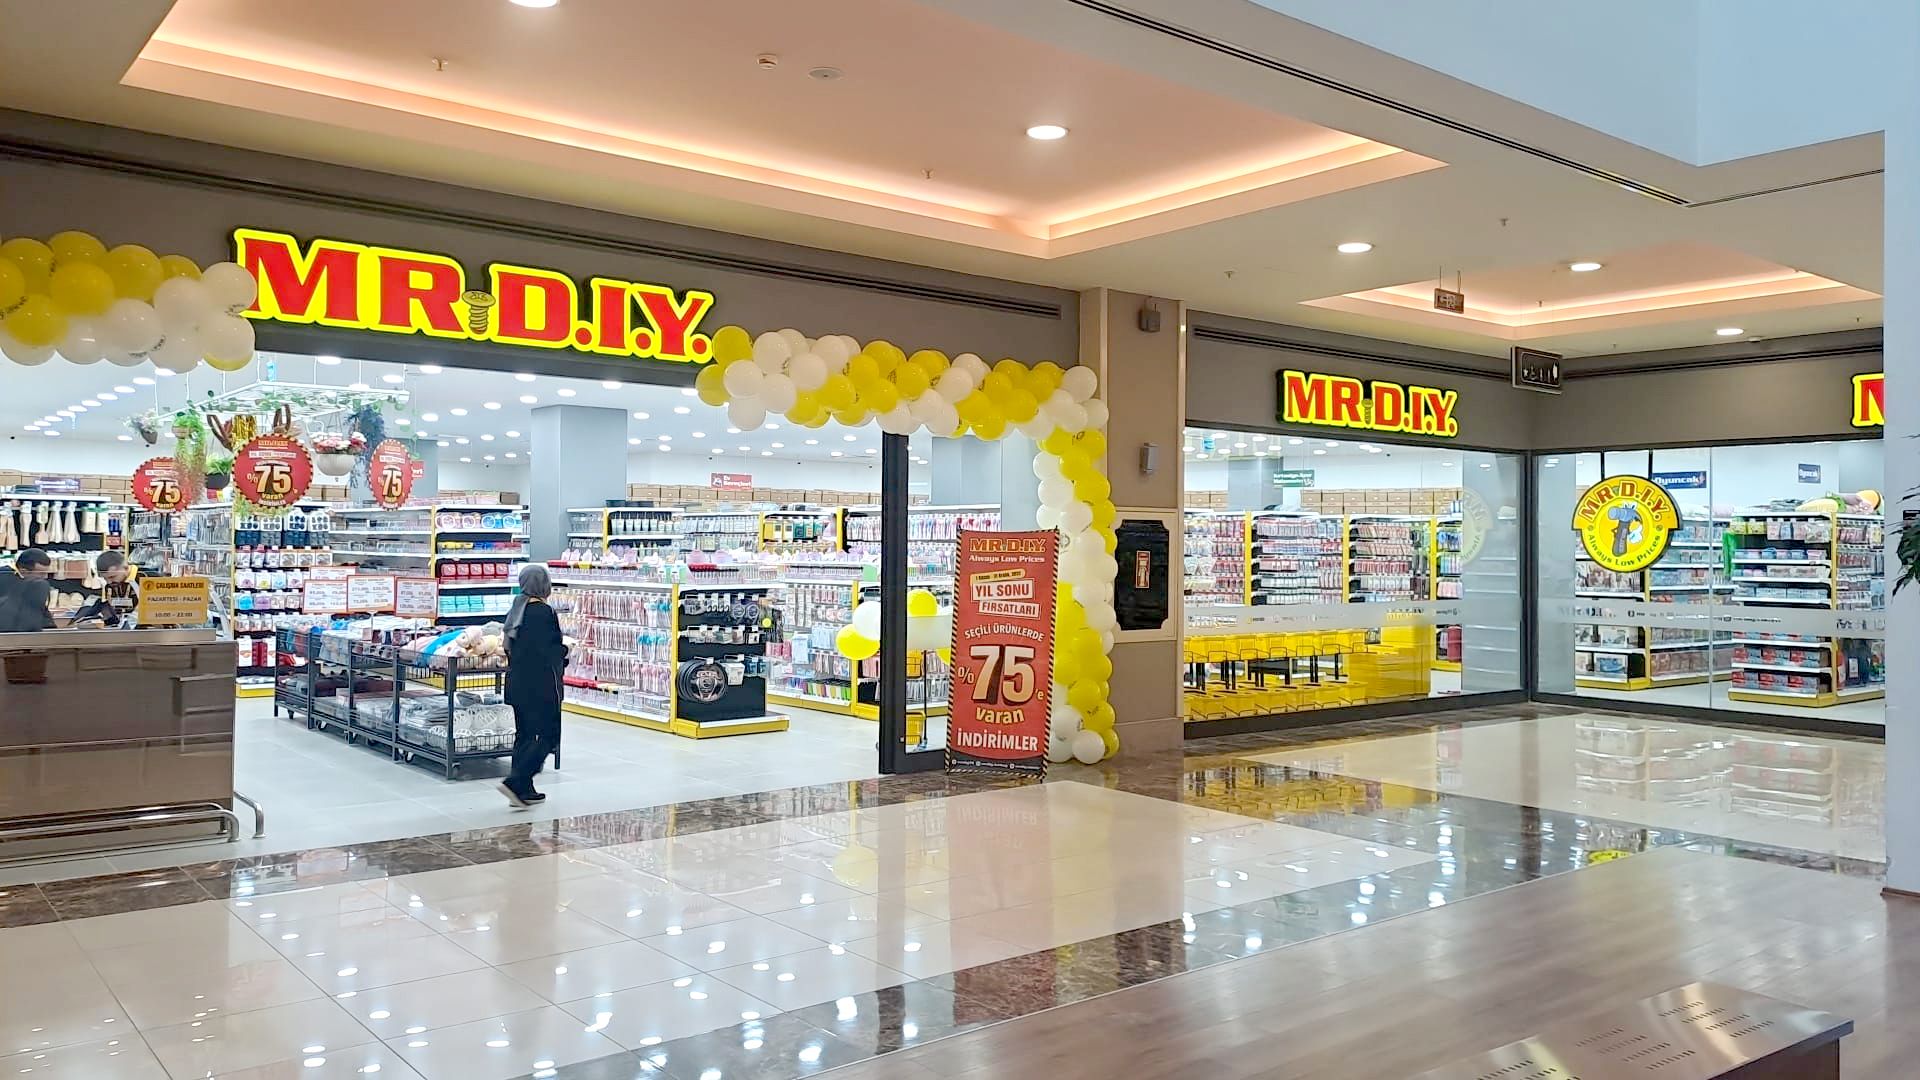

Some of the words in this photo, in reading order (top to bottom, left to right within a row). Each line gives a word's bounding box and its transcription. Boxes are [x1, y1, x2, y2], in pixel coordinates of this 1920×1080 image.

[1587, 533, 1612, 563] Always
[1615, 558, 1636, 567] Low
[1636, 535, 1661, 562] Prices
[968, 554, 999, 564] Always
[1000, 555, 1018, 563] Low
[1019, 555, 1045, 563] Prices
[975, 584, 993, 597] YIL
[996, 583, 1030, 597] SONU
[981, 601, 1036, 615] FIRSATLARI
[993, 622, 1045, 642] ÜRÜNLERDE
[976, 707, 1025, 724] varan
[957, 728, 1038, 751] İNDİRİMLER
